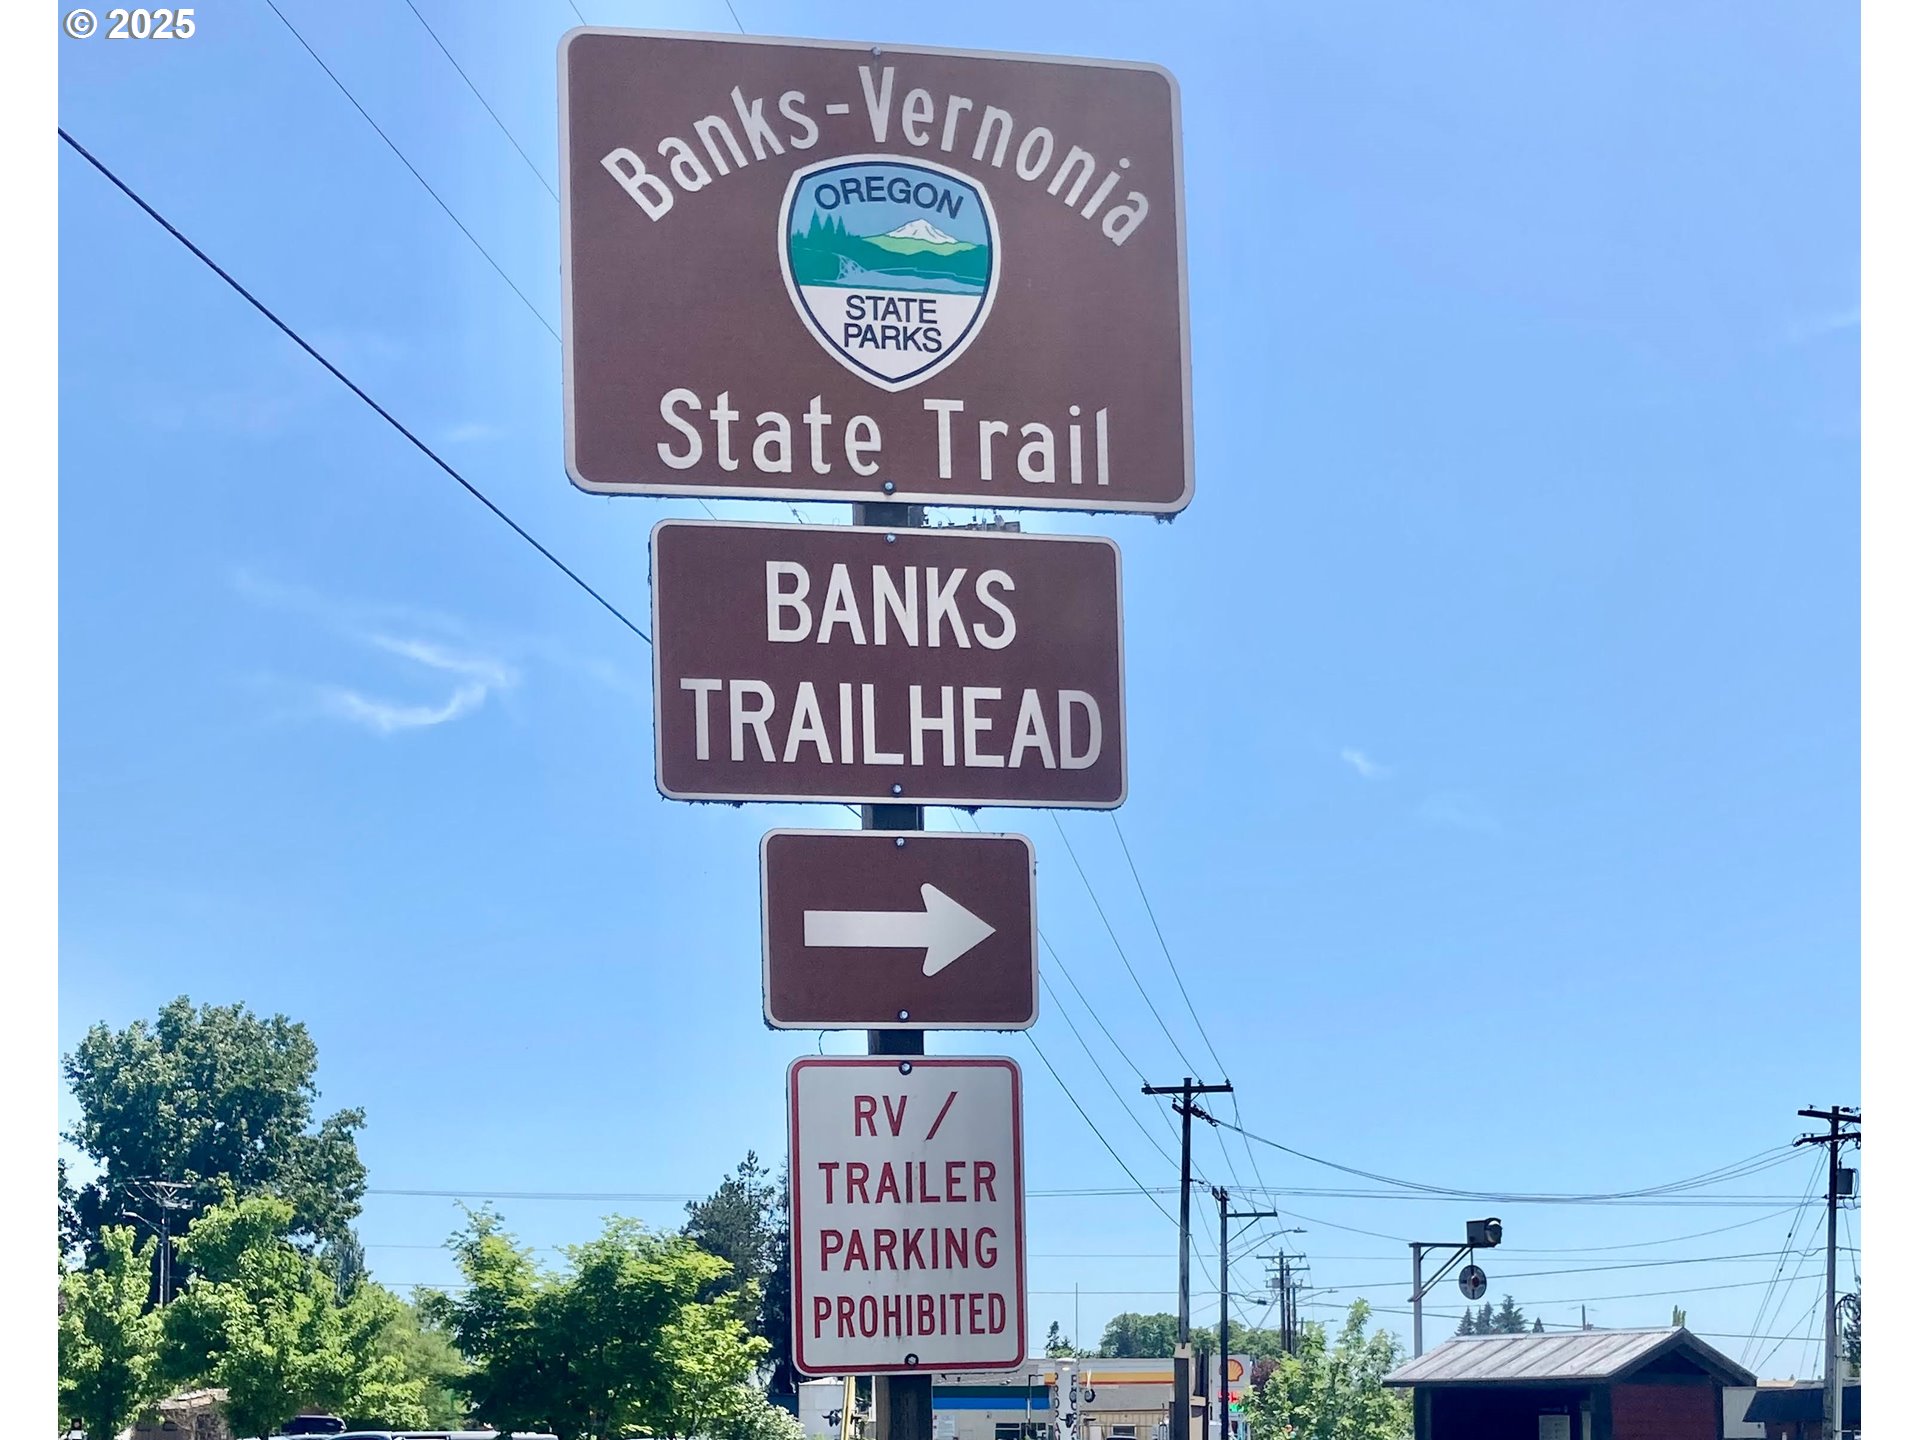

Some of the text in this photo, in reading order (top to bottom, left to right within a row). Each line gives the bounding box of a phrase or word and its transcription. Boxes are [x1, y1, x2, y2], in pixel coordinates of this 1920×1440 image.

[601, 65, 1149, 247] Banks-Vernonia
[814, 176, 964, 220] OREGON
[845, 294, 938, 325] STATE
[843, 323, 942, 353] PARKS
[657, 388, 1110, 486] State Trail
[765, 560, 1017, 650] BANKS
[680, 678, 1103, 770] TRAILHEAD
[853, 1090, 959, 1141] RV /
[818, 1161, 997, 1204] TRAILER
[820, 1227, 998, 1271] PARKING
[813, 1293, 1006, 1339] PROHIBITED
